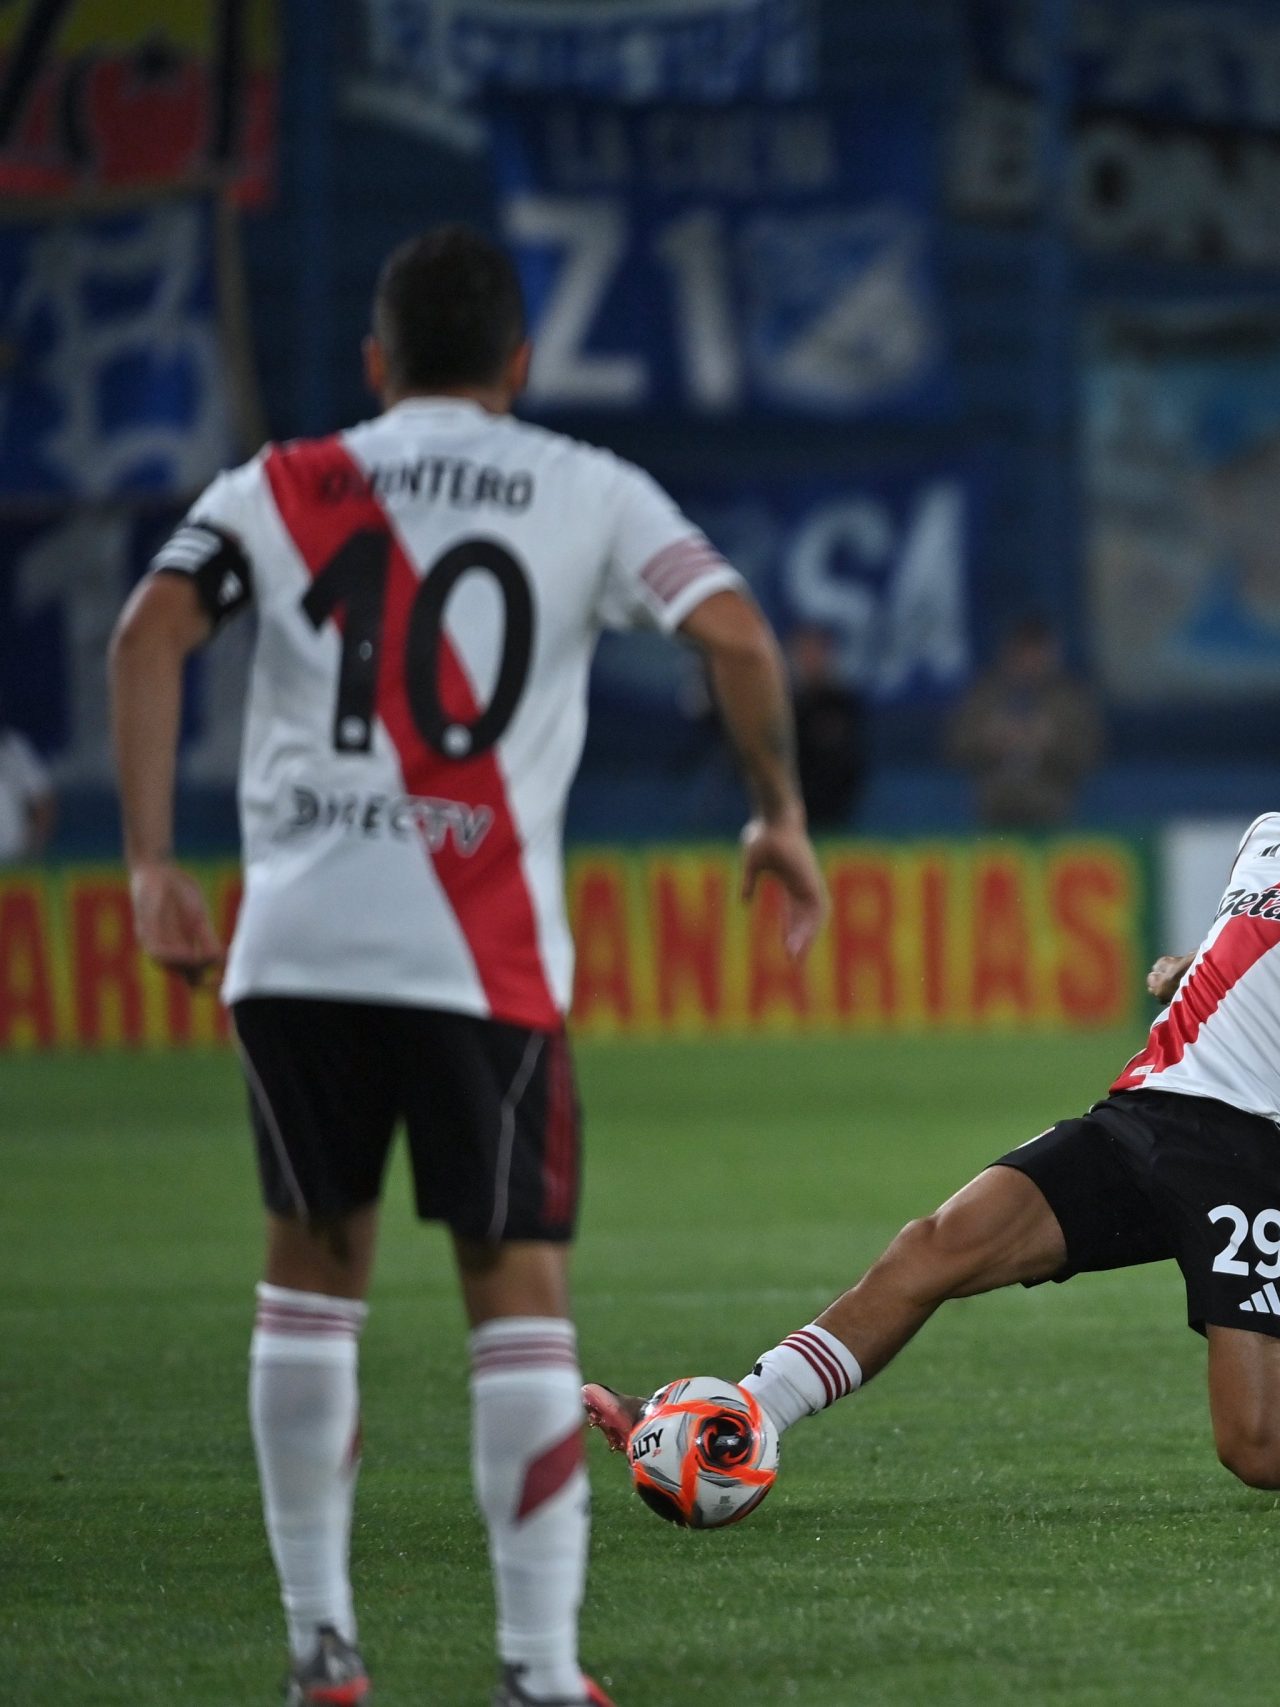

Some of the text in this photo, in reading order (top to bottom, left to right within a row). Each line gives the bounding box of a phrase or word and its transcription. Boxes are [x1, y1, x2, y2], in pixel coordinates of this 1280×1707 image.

[320, 455, 535, 513] QUINTERO
[302, 527, 535, 762] 10
[568, 852, 1130, 1032] ANARIAS
